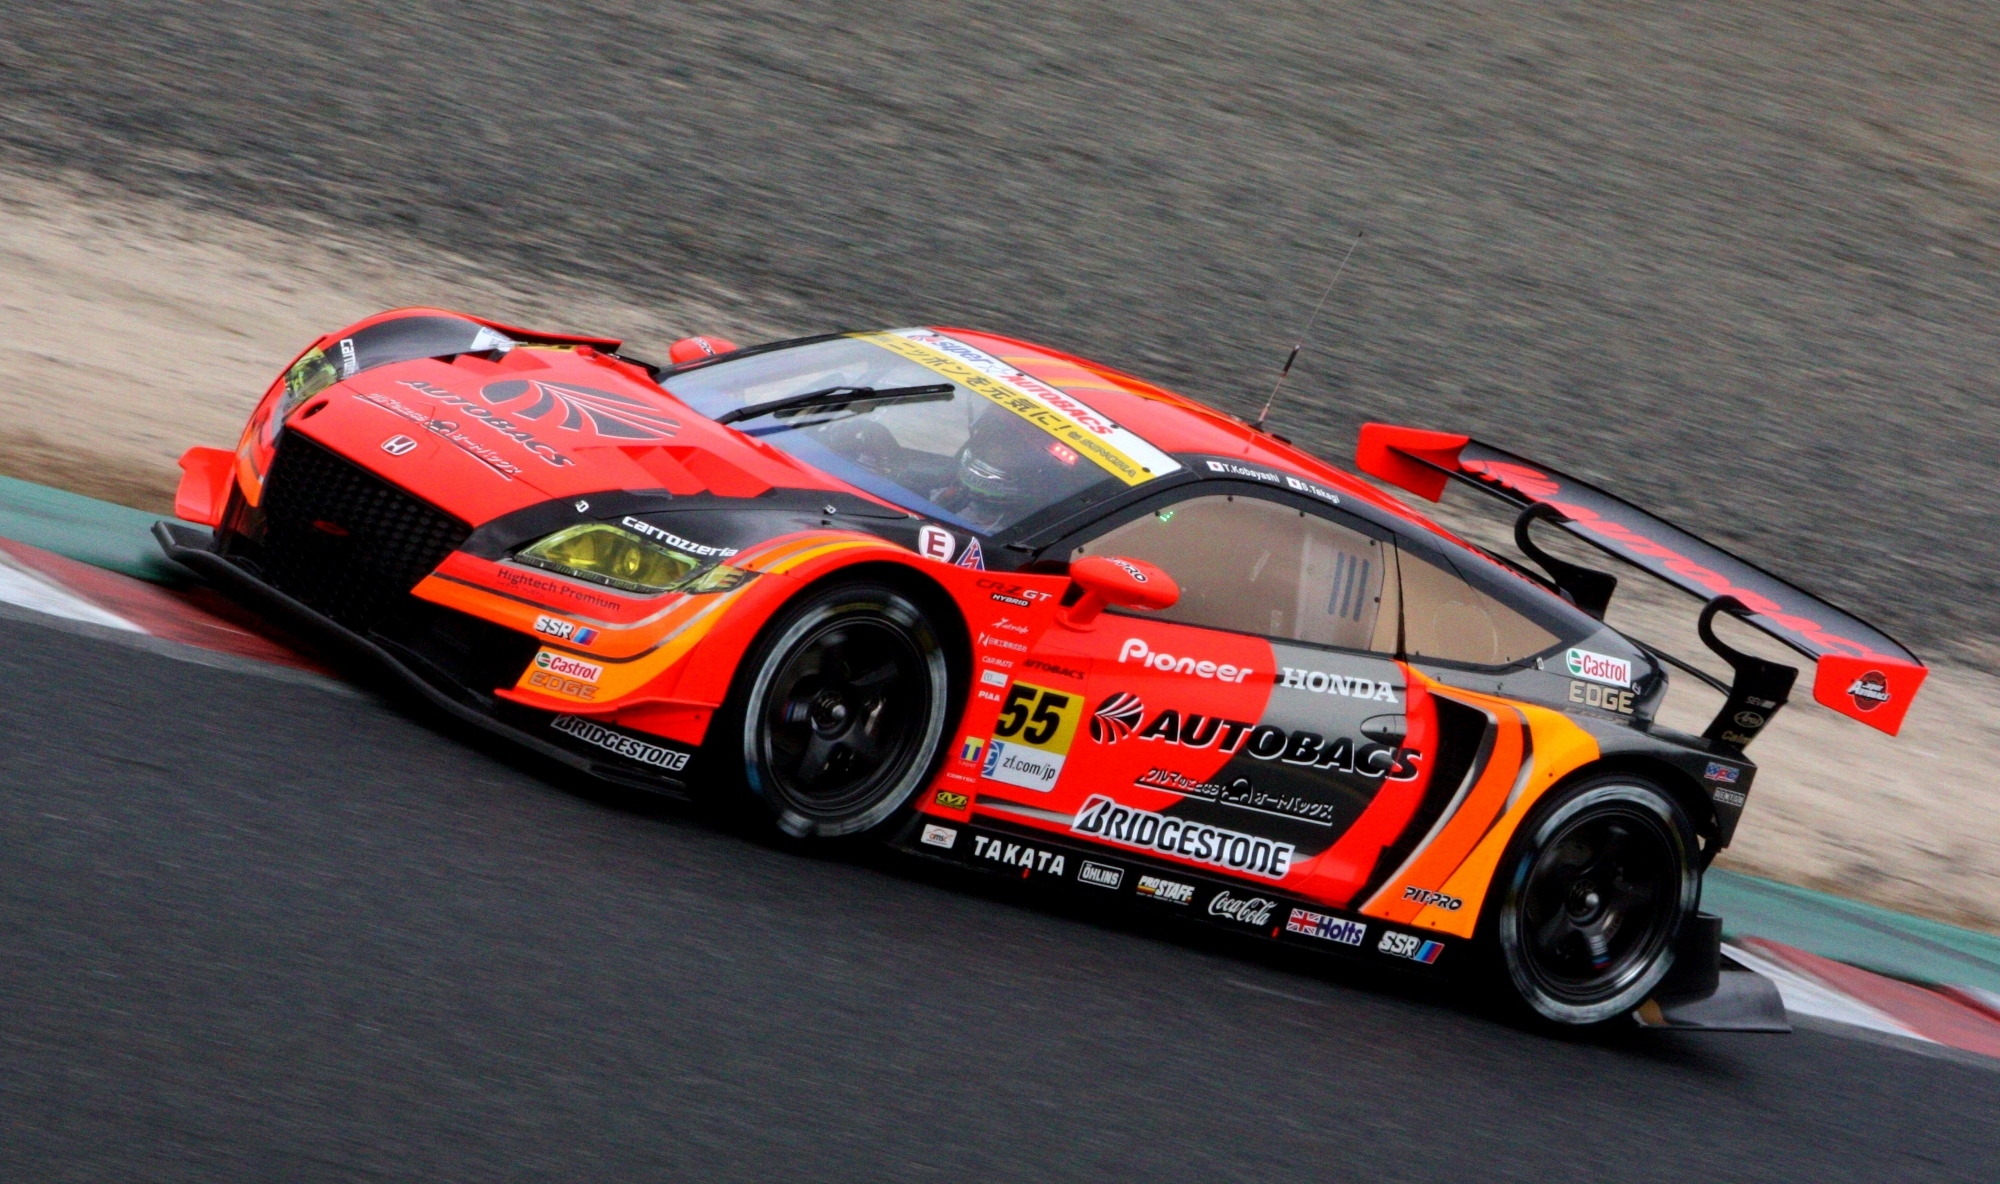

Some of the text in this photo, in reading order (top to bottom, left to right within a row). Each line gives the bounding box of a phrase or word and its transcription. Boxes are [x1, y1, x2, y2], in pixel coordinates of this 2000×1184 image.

[997, 374, 1115, 436] AUTOBACS
[396, 380, 577, 468] AUTOBACS
[1223, 463, 1281, 483] T.Kobayashi
[621, 515, 739, 558] carrozzeria
[497, 568, 558, 595] Hightech
[559, 585, 622, 612] Premium
[991, 593, 1030, 607] HYBRID
[1022, 589, 1053, 602] GT
[535, 614, 575, 640] SSR
[550, 656, 598, 681] Castrol
[1117, 638, 1254, 684] Pioneer
[1582, 654, 1628, 683] Castrol
[528, 671, 599, 701] EDGE
[977, 690, 1001, 702] PIAA
[1279, 667, 1400, 704] HONDA
[1568, 680, 1636, 715] EDGE
[993, 684, 1070, 746] 55
[551, 713, 691, 771] BRIDGESTONE
[1138, 709, 1424, 783] AUTOBACS
[1002, 752, 1056, 780] zf.com/jp
[1073, 797, 1294, 879] BRIDGESTONE
[974, 835, 1066, 876] TAKATA
[1082, 863, 1119, 885] ÖHLINS
[1315, 915, 1365, 946] Holts
[1378, 931, 1421, 958] SSR
